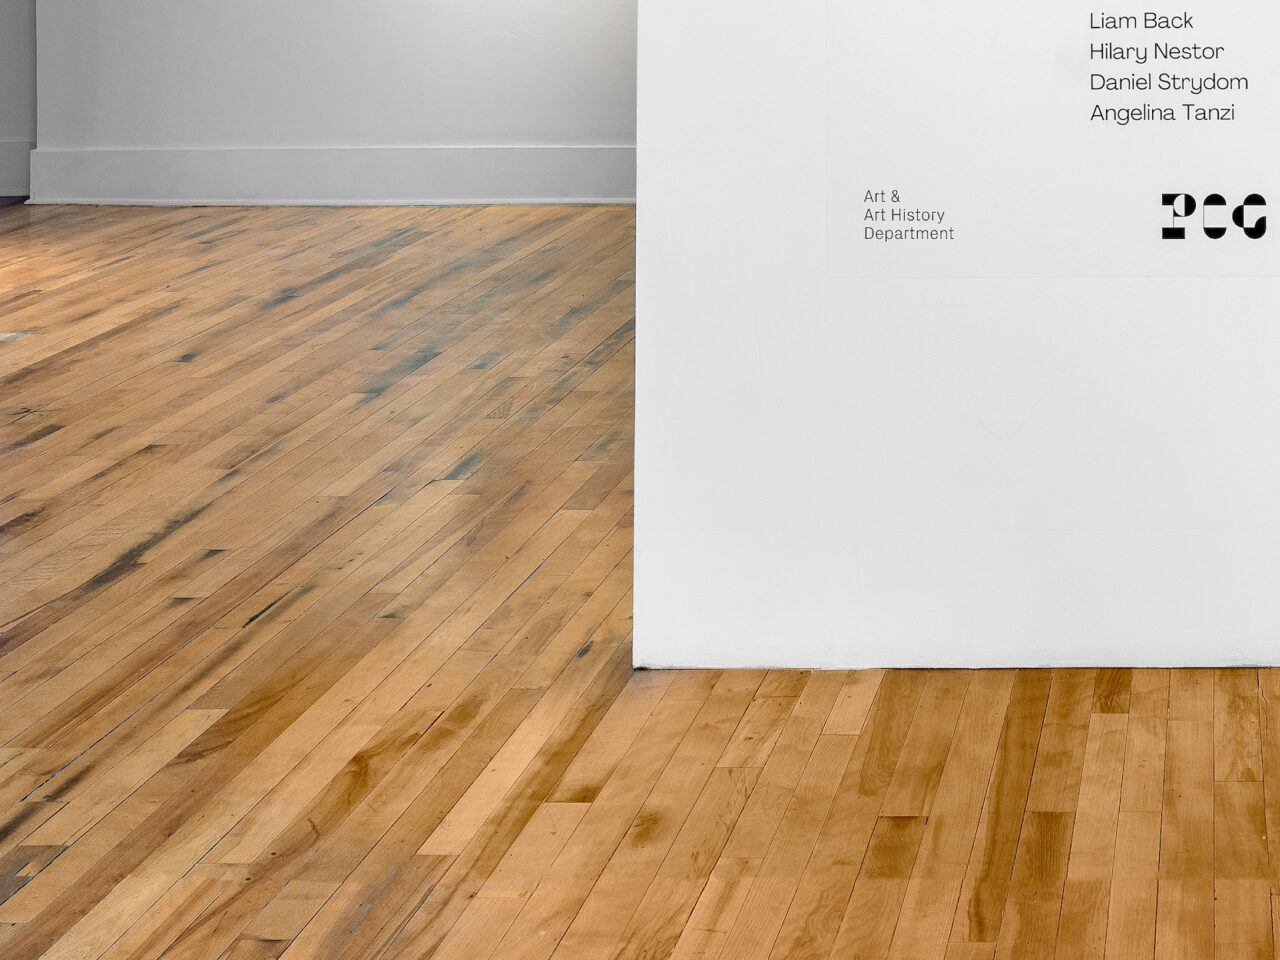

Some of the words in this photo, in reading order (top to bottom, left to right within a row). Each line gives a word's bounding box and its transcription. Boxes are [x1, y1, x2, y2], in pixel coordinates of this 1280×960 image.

[1090, 12, 1137, 30] Liam
[1143, 11, 1194, 30] Back
[1090, 41, 1148, 65] Hilary
[1154, 42, 1225, 60] Nestor
[1090, 72, 1152, 91] Daniel
[1157, 72, 1249, 95] Strydom
[1089, 103, 1177, 126] Angelina
[1181, 103, 1235, 121] Tanzi
[863, 189, 887, 203] Art
[890, 189, 901, 203] &
[863, 208, 886, 222] Art
[891, 207, 945, 225] History
[1161, 192, 1267, 240] PCG
[863, 226, 955, 243] Department
